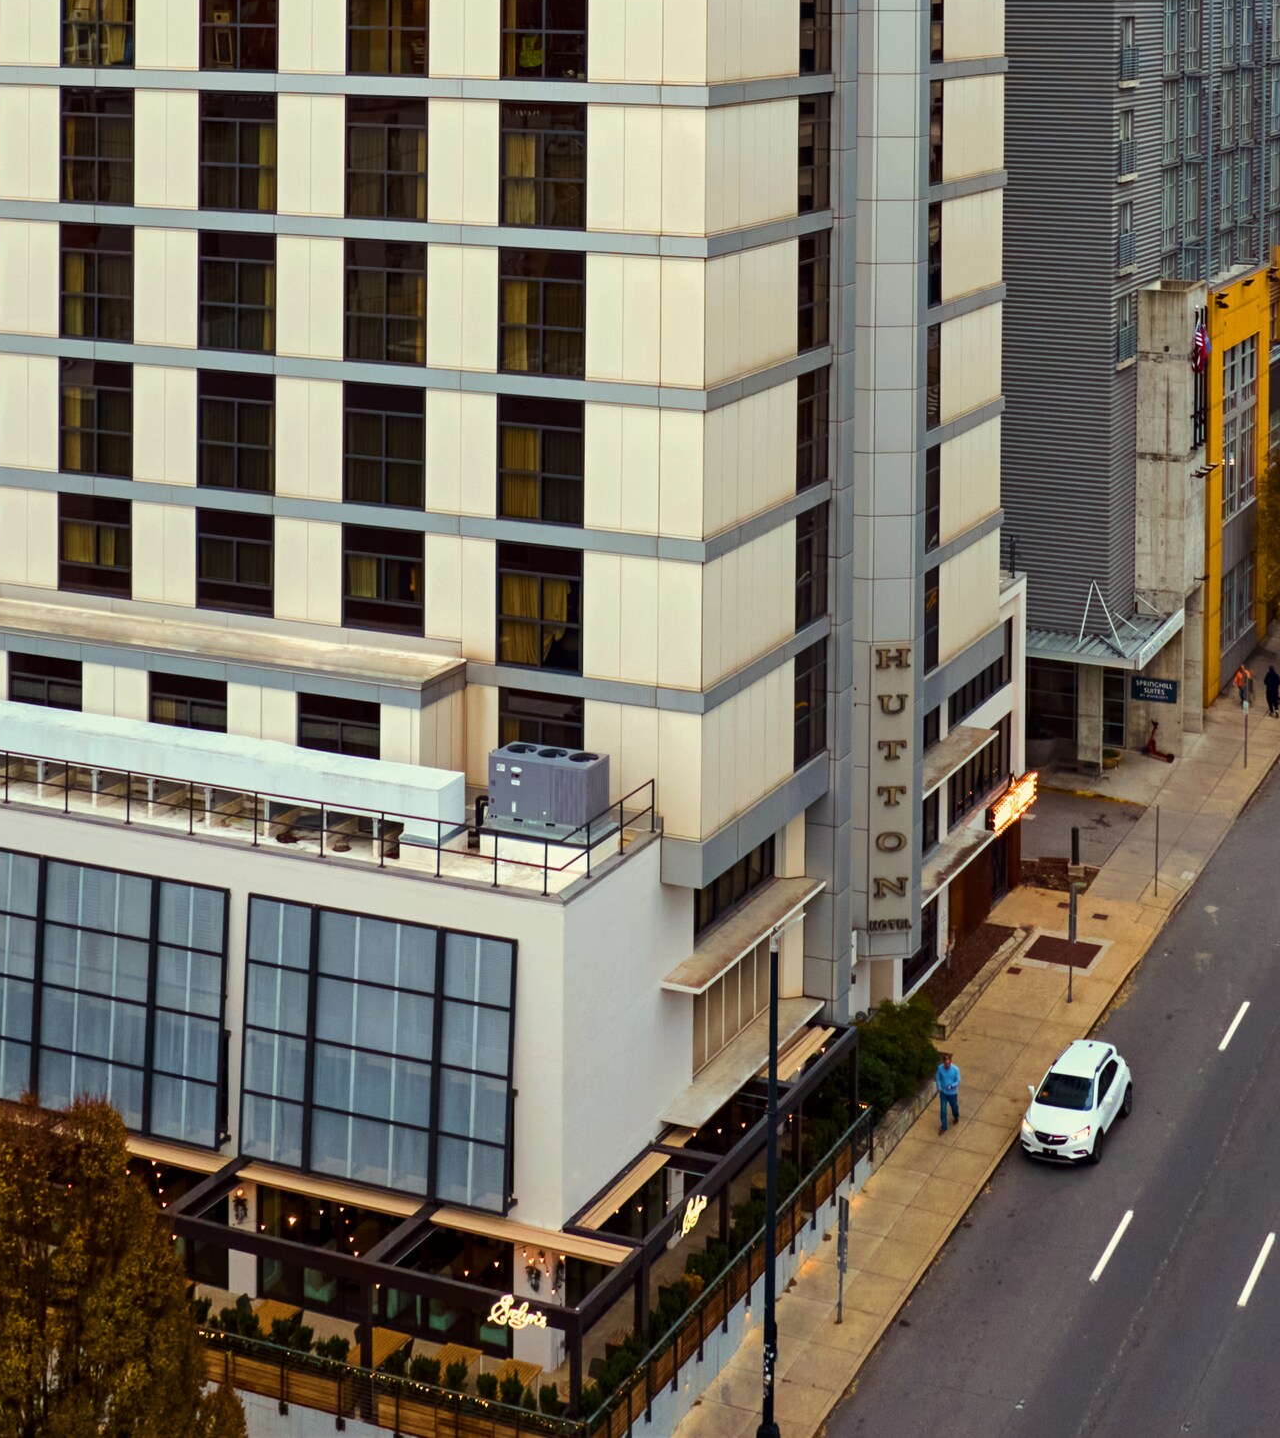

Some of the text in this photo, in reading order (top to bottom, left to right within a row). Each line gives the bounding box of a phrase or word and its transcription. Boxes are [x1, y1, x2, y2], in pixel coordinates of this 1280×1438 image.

[1136, 679, 1173, 690] SPRINGHILL
[1144, 687, 1165, 695] SUITES
[873, 647, 911, 899] HUTTON
[869, 918, 912, 931] HOTEL
[487, 1293, 548, 1329] Evelyn's
